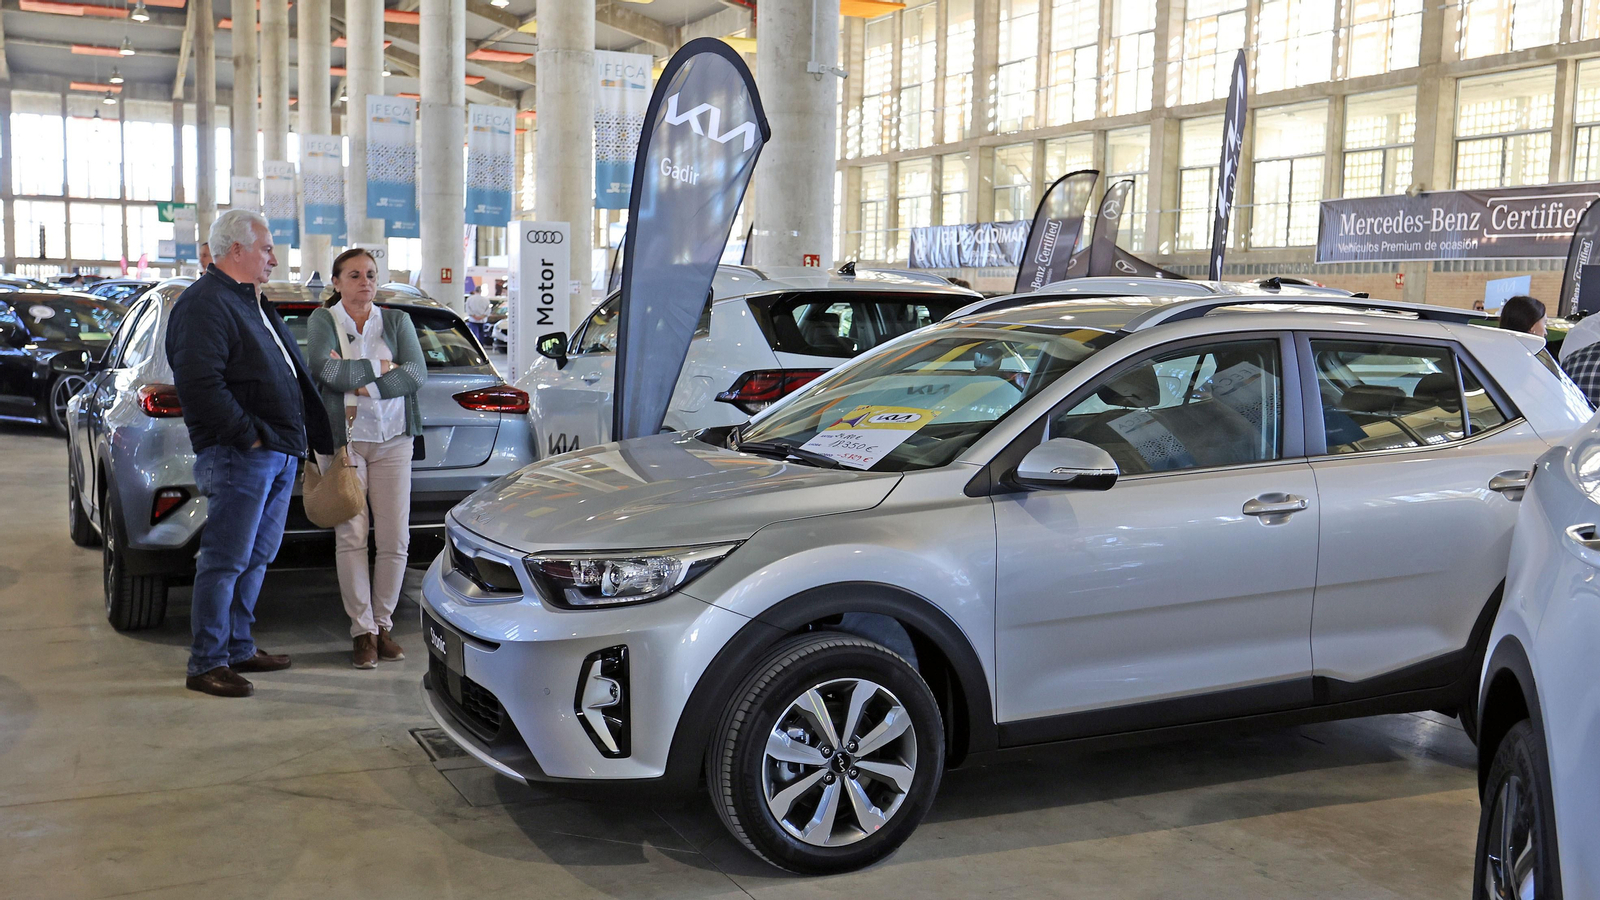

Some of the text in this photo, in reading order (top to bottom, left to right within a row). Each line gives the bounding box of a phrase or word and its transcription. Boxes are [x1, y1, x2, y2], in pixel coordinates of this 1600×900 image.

[600, 64, 646, 79] IFECA
[371, 104, 411, 117] IFECA
[472, 113, 510, 127] IFECA
[664, 92, 756, 153] KIA
[308, 142, 340, 151] IFECA
[660, 157, 700, 186] Gadir
[1339, 207, 1481, 237] Mercedes-Benz
[1038, 221, 1059, 263] Certified
[1381, 241, 1421, 252] Premium
[1424, 239, 1437, 251] de
[1440, 237, 1478, 250] ocasión
[536, 258, 554, 325] Motor
